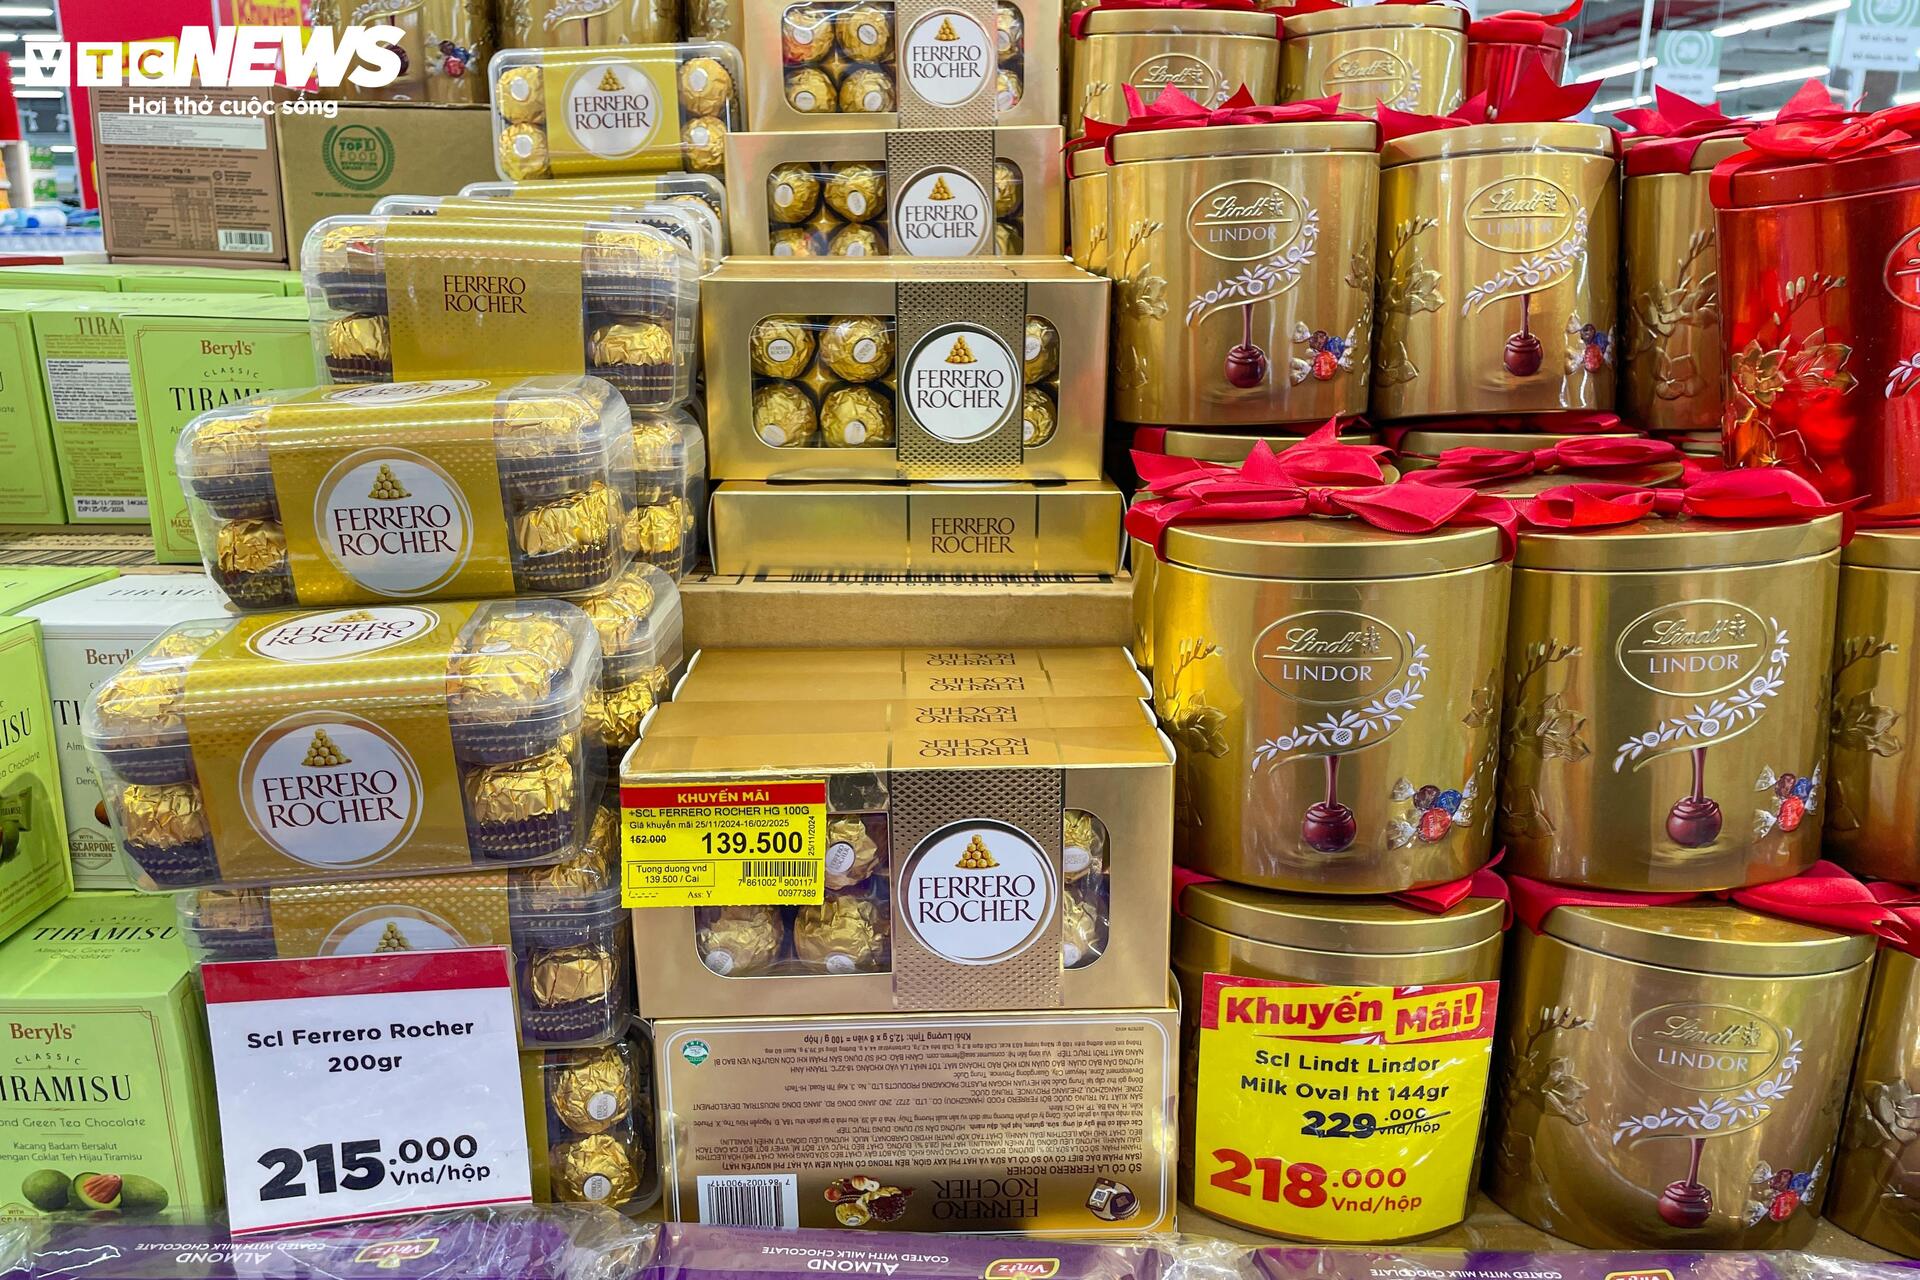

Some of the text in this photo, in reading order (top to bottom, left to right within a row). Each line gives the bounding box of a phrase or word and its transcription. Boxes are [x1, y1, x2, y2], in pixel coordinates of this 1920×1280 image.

[911, 44, 982, 63] FERRERO
[912, 60, 982, 79] ROCHER
[574, 94, 649, 115] FERRERO
[574, 110, 650, 130] ROCHER
[1205, 196, 1270, 219] Lindt
[1481, 188, 1545, 214] Lindt
[904, 203, 979, 223] FERRERO
[905, 220, 979, 240] ROCHER
[1209, 226, 1277, 243] LINDOR
[442, 275, 527, 297] FERRERO
[442, 293, 527, 315] ROCHER
[200, 339, 253, 360] Beryl's
[203, 366, 260, 378] CLASSIC
[916, 368, 1004, 389] FERRERO
[916, 387, 1004, 409] ROCHER
[332, 504, 452, 533] FERRERO
[930, 516, 1015, 536] FERRERO
[338, 527, 457, 557] ROCHER
[930, 535, 1015, 554] ROCHER
[265, 630, 403, 646] ROCHER
[276, 620, 415, 637] FERRERO
[1642, 619, 1730, 646] Lindt
[1276, 628, 1363, 654] Lindt
[1282, 664, 1374, 682] LINDOR
[1649, 654, 1739, 674] LINDOR
[929, 676, 1023, 684] ROCHER
[929, 683, 1025, 692] FERRERO
[915, 706, 1016, 715] ROCHER
[915, 714, 1018, 724] FERRERO
[919, 738, 1027, 748] ROCHER
[919, 746, 1030, 757] FERRERO
[261, 769, 399, 804] FERRERO
[678, 788, 770, 804] KHUYẾN MÃI
[267, 797, 404, 830] ROCHER
[659, 808, 712, 817] FERRERO
[714, 806, 761, 816] ROCHER
[764, 806, 780, 816] HG
[783, 806, 810, 815] 100G
[695, 818, 790, 829] 25/11/2024-16/02/2025
[701, 831, 803, 855] 139.500
[808, 815, 816, 857] 25/11/2024
[636, 864, 708, 874] Tuong duong vnd
[644, 874, 679, 884] 139.500
[738, 878, 813, 887] 7 861002 900117
[918, 874, 1036, 899] FERRERO
[706, 890, 713, 899] Y
[778, 889, 817, 898] 00977389
[919, 898, 1036, 924] ROCHER
[32, 926, 180, 941] TIRAMISU
[1226, 991, 1476, 1036] Khuyến Mãi!
[9, 1022, 74, 1044] Beryl's
[247, 1019, 474, 1049] Scl Ferrero Rocher
[803, 1034, 818, 1044] hộp
[824, 1034, 830, 1042] g
[832, 1035, 844, 1044] 100
[852, 1035, 868, 1044] viên
[882, 1032, 888, 1040] g
[888, 1032, 904, 1042] 12,5
[1653, 1015, 1744, 1045] Lindt
[15, 1052, 82, 1065] CLASSIC
[328, 1053, 403, 1074] 200gr
[1255, 1050, 1440, 1074] Scl Lindt Lindor
[1657, 1048, 1749, 1072] LINDOR
[1240, 1075, 1450, 1102] Milk Oval ht 144gr
[22, 1117, 146, 1128] Green Tea Chocolate
[13, 1142, 118, 1152] Kacang Badam Bersalut
[32, 1153, 60, 1161] Coklat
[62, 1153, 78, 1161] Teh
[79, 1153, 103, 1163] Hijau
[104, 1153, 143, 1161] Tiramisu
[256, 1133, 479, 1202] 215.000
[390, 1162, 491, 1187] Vnd/hộp
[1006, 1162, 1142, 1176] SÔ CÔ LA FERRERO ROCHER
[746, 1178, 779, 1186] 861002
[930, 1176, 1038, 1198] ROCHER
[1210, 1148, 1407, 1210] 218.000
[932, 1198, 1039, 1219] FERRERO
[1331, 1195, 1422, 1214] Vnd/hộp
[175, 1252, 272, 1264] ALMOND
[761, 1246, 949, 1264] COATED WITH MILK CHOCOLATE
[806, 1258, 900, 1276] ALMOND
[996, 1262, 1049, 1275] Vintz
[1446, 1270, 1475, 1278] MILK
[1478, 1270, 1510, 1278] WITH
